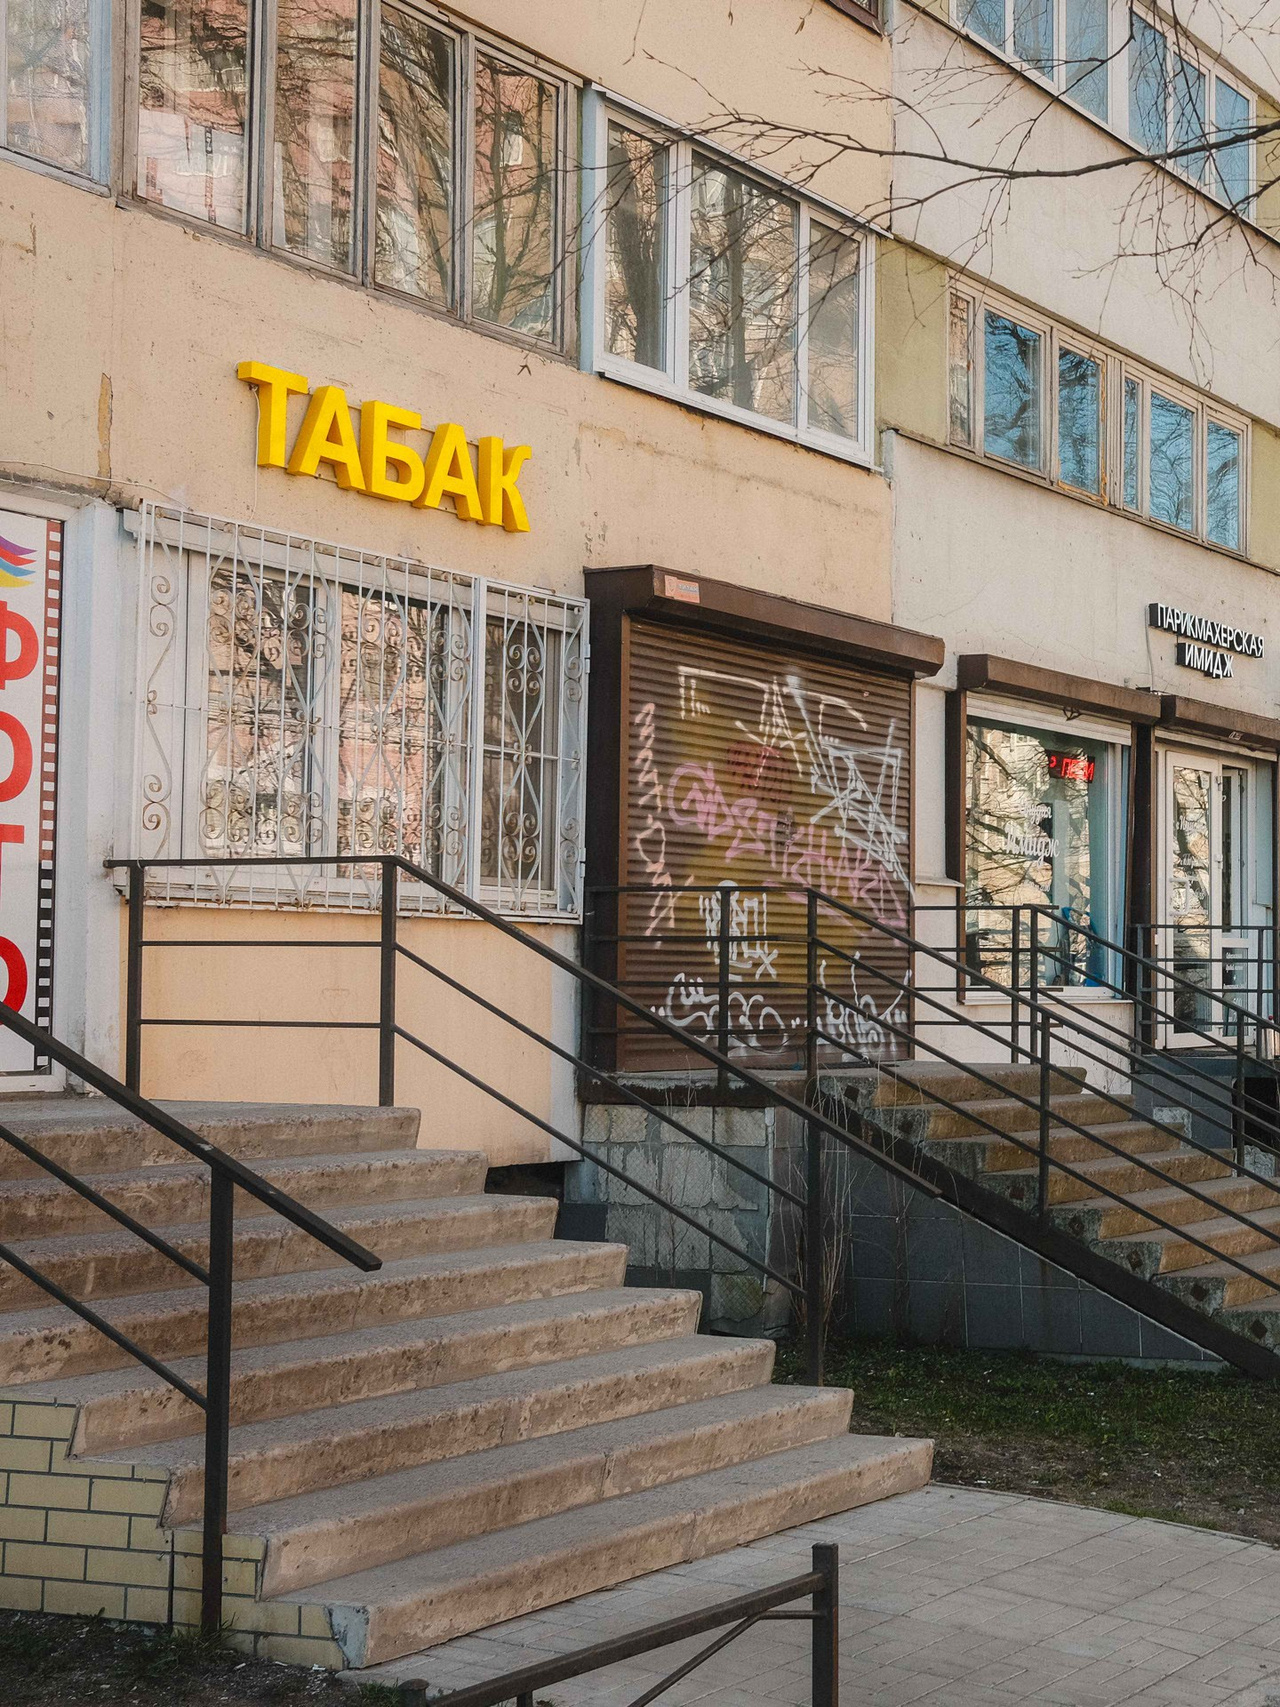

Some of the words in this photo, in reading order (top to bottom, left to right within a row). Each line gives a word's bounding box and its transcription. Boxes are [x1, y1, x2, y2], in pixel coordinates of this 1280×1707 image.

[237, 361, 532, 533] ТАБАК
[1155, 603, 1265, 658] ПАРИКМАХЕРСКАЯ
[1183, 642, 1235, 679] ИМИДЖ
